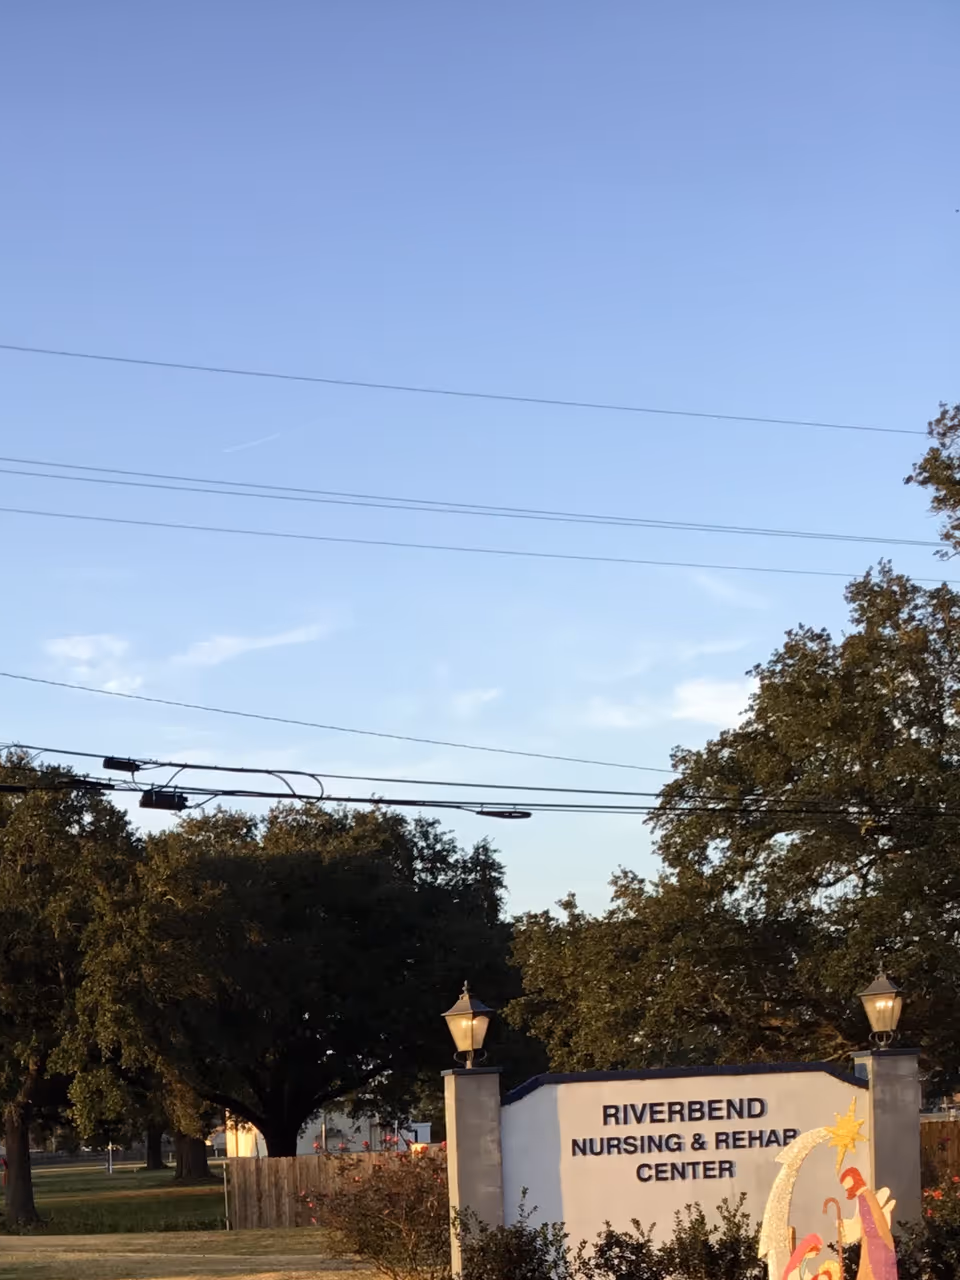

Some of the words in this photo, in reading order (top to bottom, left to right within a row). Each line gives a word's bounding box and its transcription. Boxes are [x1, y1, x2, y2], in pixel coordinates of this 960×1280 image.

[602, 1097, 768, 1126] RIVERBEND
[571, 1133, 683, 1157] NURSING
[690, 1132, 707, 1151] &
[636, 1160, 736, 1182] CENTER
